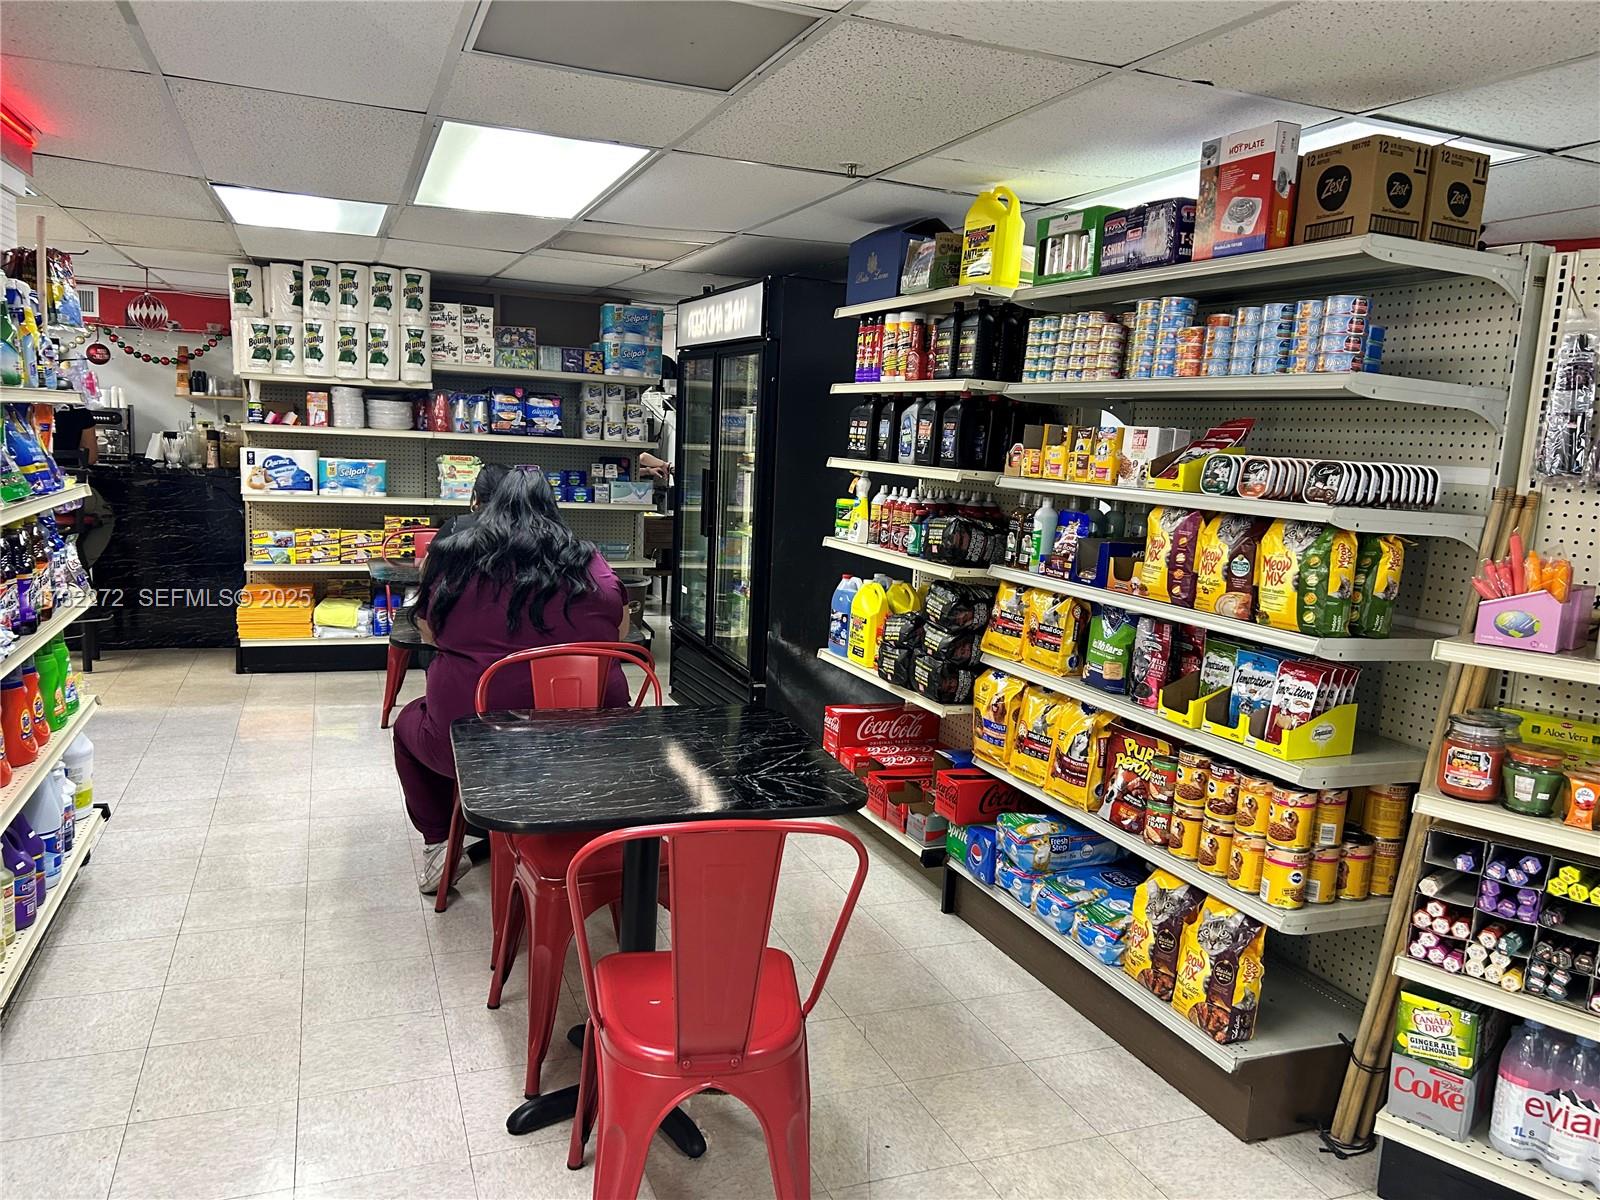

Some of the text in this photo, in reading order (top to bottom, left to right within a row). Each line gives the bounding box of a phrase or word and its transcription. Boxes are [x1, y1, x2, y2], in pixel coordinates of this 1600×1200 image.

[1244, 139, 1265, 150] PLATE
[1379, 140, 1389, 154] 12
[1306, 155, 1316, 168] 12
[1441, 150, 1450, 163] 12
[1321, 176, 1349, 200] Zest
[1389, 181, 1410, 197] Zest
[1450, 191, 1470, 205] Zest
[624, 313, 650, 324] Selpak
[622, 350, 646, 359] Selpak
[339, 466, 366, 477] Selpak
[1263, 551, 1292, 572] Meow
[1336, 543, 1348, 568] Meow
[1265, 571, 1287, 586] Mix
[1001, 611, 1014, 620] small
[1040, 624, 1053, 632] small
[1276, 679, 1314, 700] Temptions
[857, 713, 926, 741] Coca-Cola
[990, 723, 1006, 731] ADULT
[1028, 732, 1052, 744] small dog
[1544, 728, 1588, 743] Aloe Vera
[1124, 738, 1155, 763] Pup
[880, 755, 934, 766] ca-Cola
[1150, 772, 1167, 780] RAVY
[1150, 778, 1166, 786] RAIN
[1052, 844, 1068, 852] Step
[1413, 1014, 1454, 1027] CANADA
[1461, 1012, 1471, 1020] 12
[1424, 1024, 1445, 1034] DRY
[1410, 1037, 1456, 1051] GINGER ALE
[1422, 1045, 1456, 1057] LEMONADE
[1393, 1066, 1465, 1113] Coke
[1441, 1080, 1463, 1093] Diet
[1513, 1126, 1535, 1138] 1L 6
